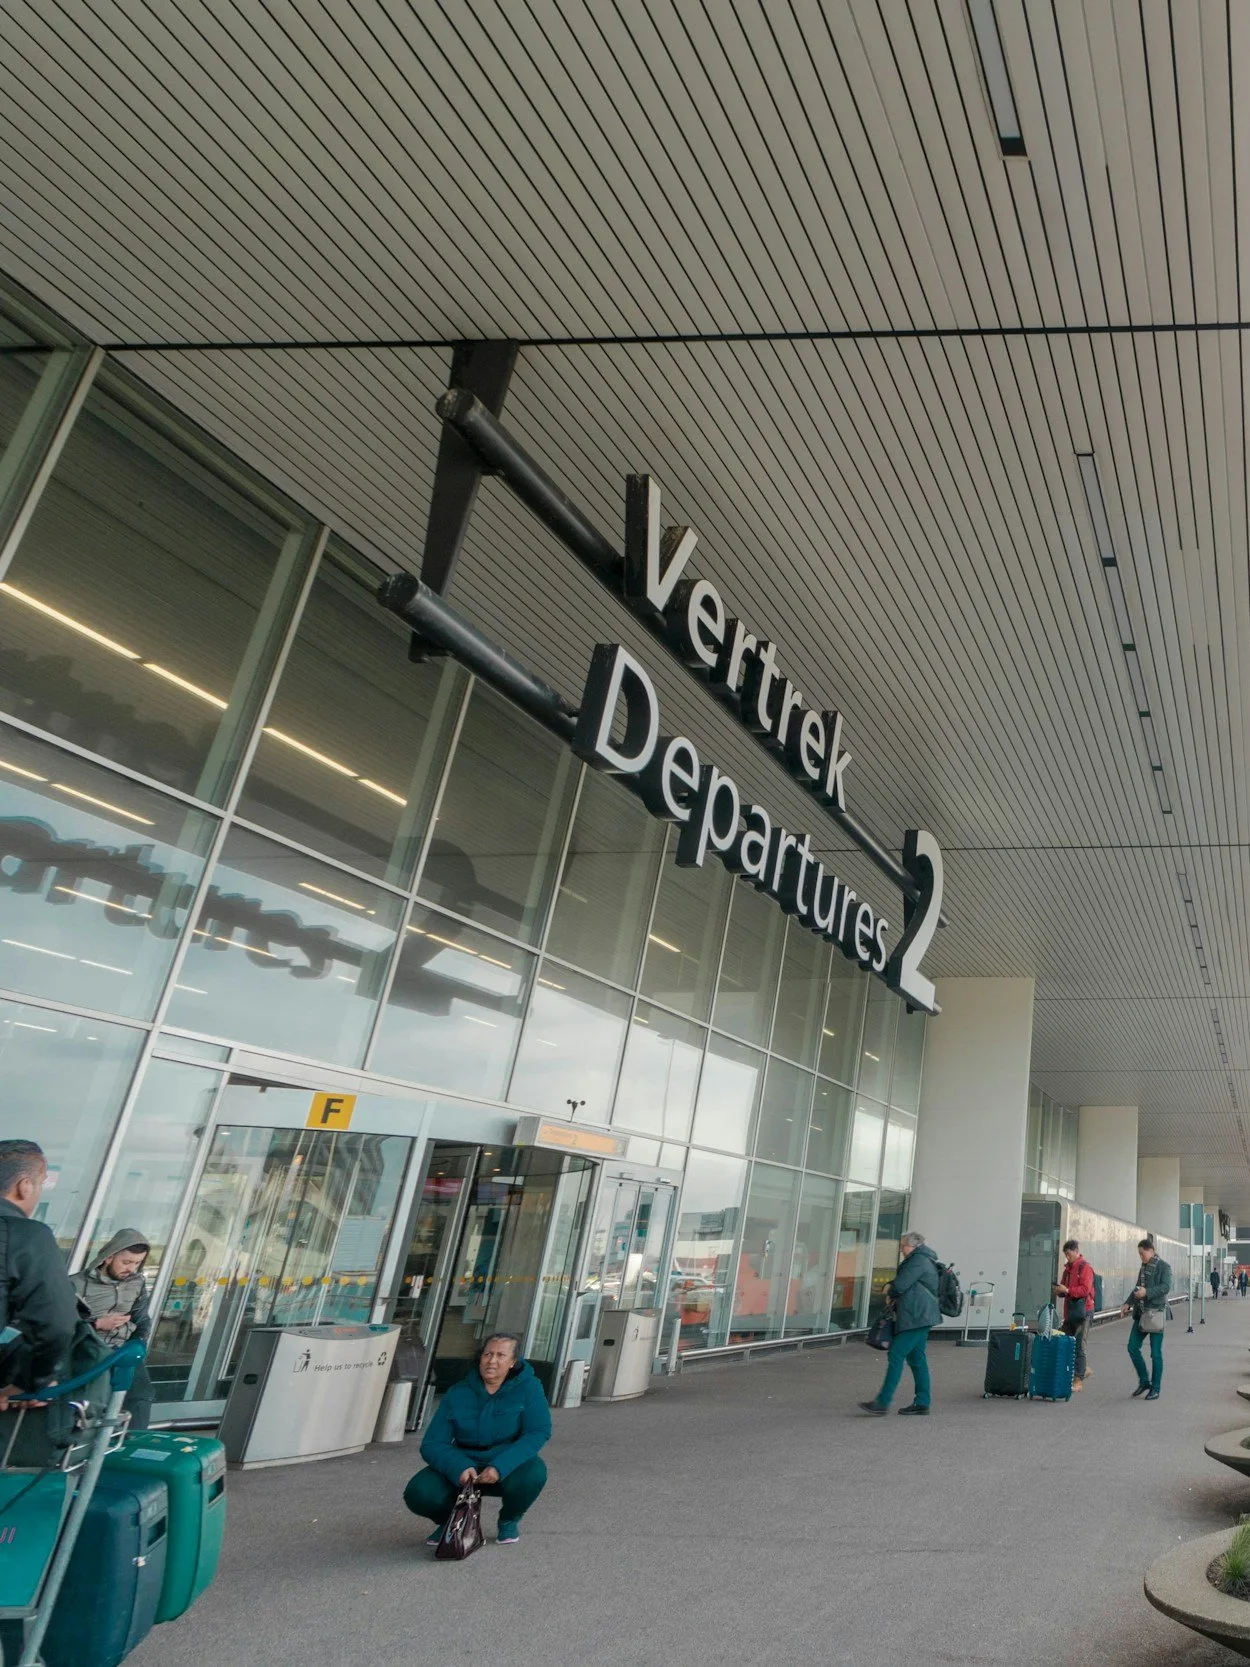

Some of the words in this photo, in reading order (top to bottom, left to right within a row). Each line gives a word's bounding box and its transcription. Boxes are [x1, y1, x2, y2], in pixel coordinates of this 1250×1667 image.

[630, 474, 853, 813] Vertrek
[583, 644, 889, 975] Departures
[892, 829, 944, 1012] 2
[320, 1098, 344, 1123] F
[314, 1363, 332, 1372] Help
[353, 1361, 374, 1370] recycle
